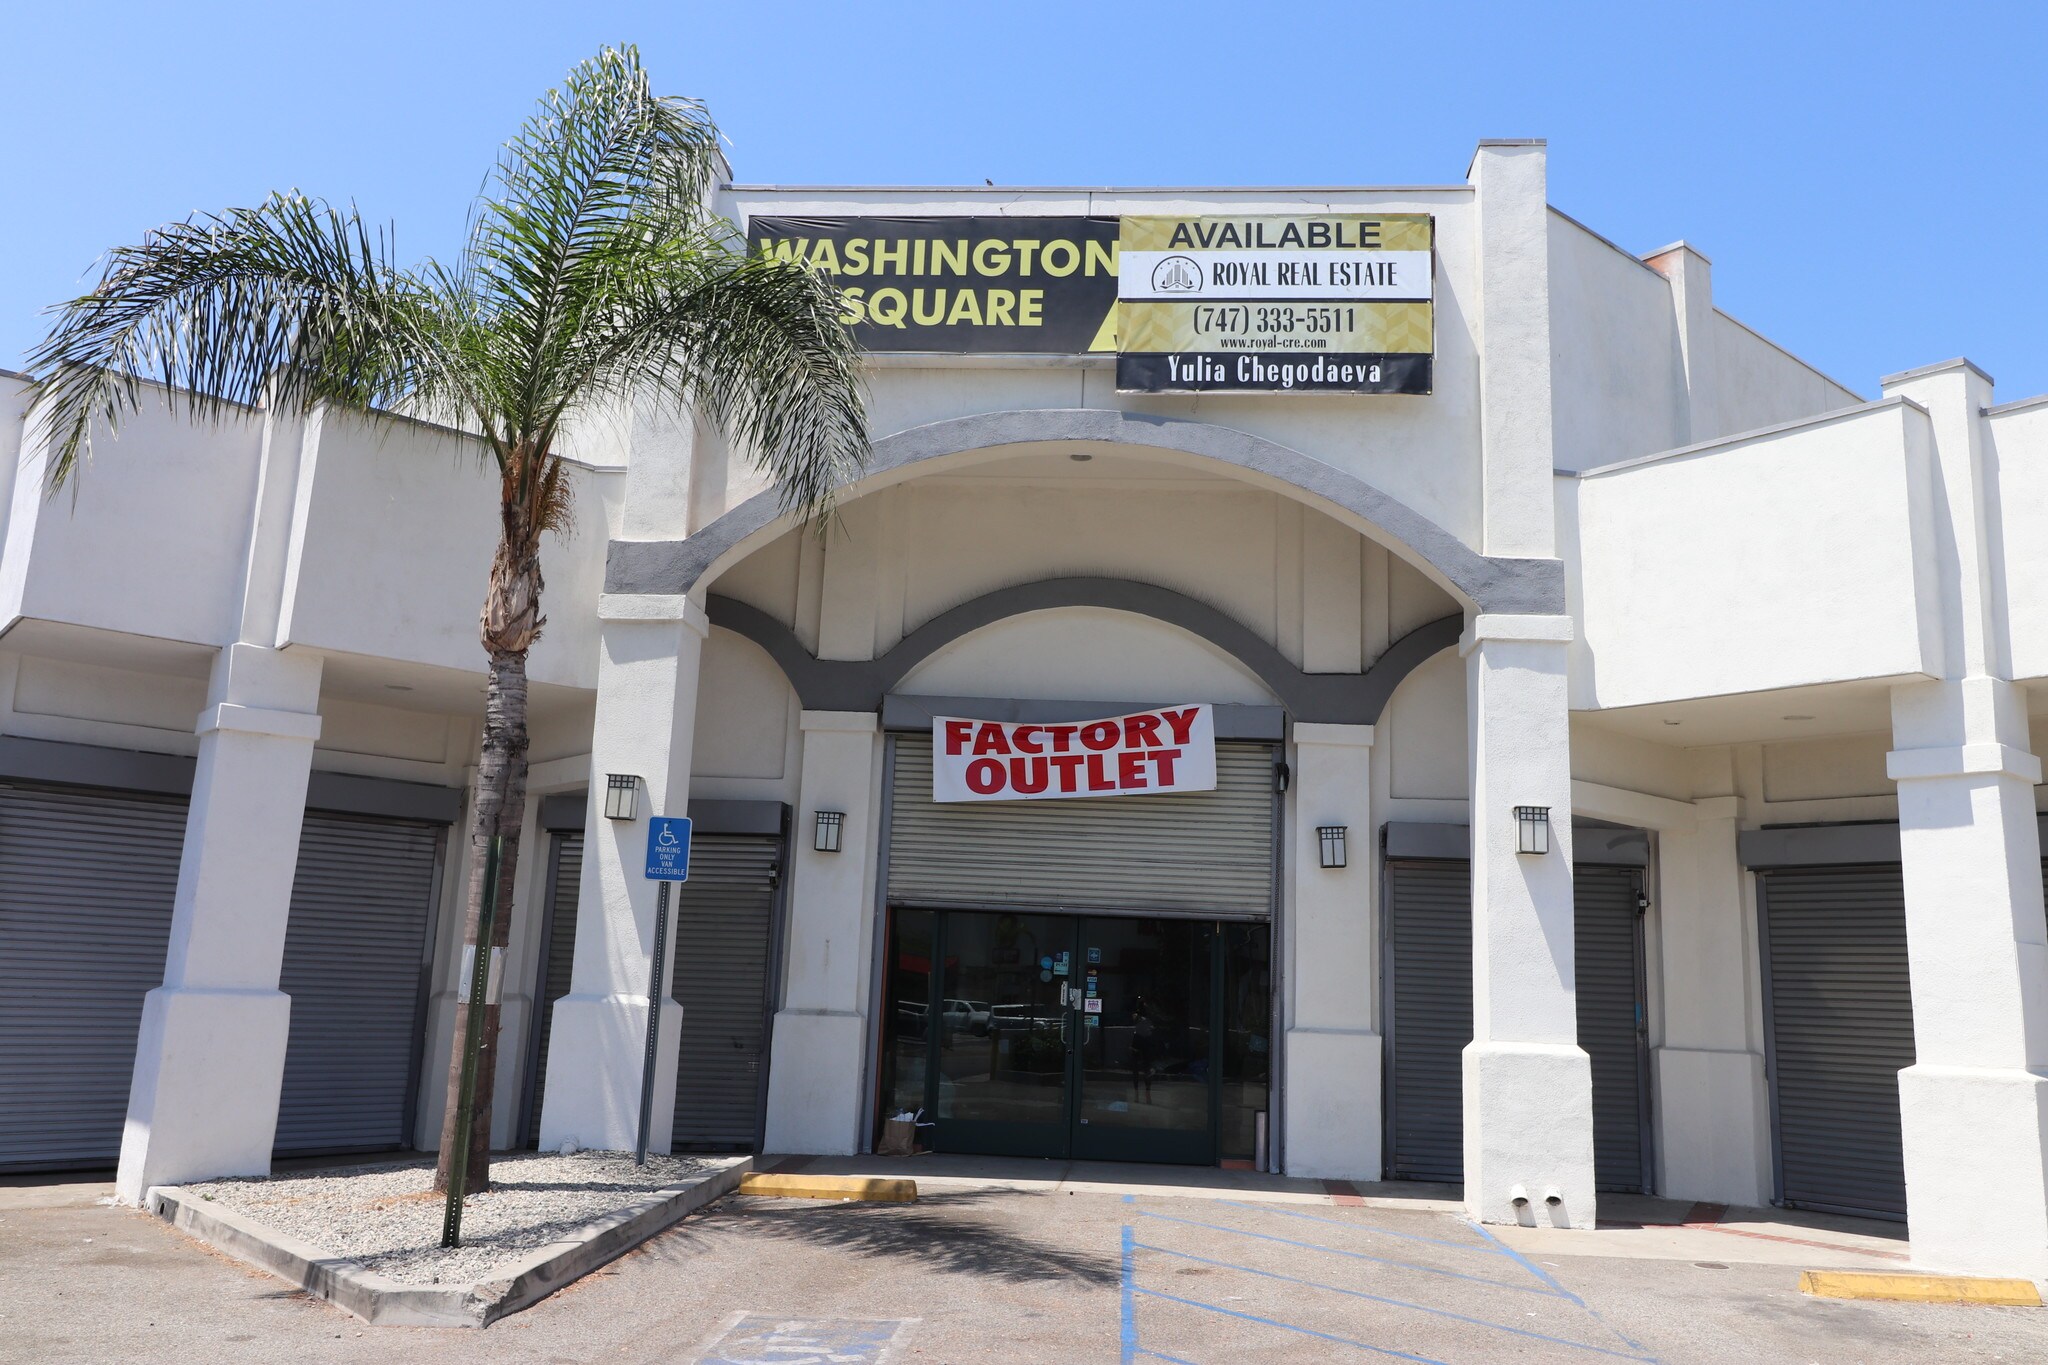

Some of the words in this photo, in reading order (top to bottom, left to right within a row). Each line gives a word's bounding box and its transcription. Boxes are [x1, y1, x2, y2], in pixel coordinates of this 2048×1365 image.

[1168, 222, 1382, 249] AVAILABLE
[760, 238, 1120, 278] WASHINGTON
[1213, 262, 1271, 286] ROYAL
[1277, 262, 1322, 286] REAL
[1329, 262, 1398, 287] ESTATE
[837, 287, 1044, 329] SQUARE
[1193, 304, 1250, 335] (747)
[1256, 307, 1355, 333] 333-5511
[1220, 335, 1327, 351] www.royal-cre.com
[1167, 355, 1226, 383] Yulia
[1237, 355, 1381, 388] Chegodaeva
[945, 707, 1199, 756] FACTORY
[965, 748, 1182, 795] OUTLET
[647, 867, 685, 875] ACCESSIBLE
